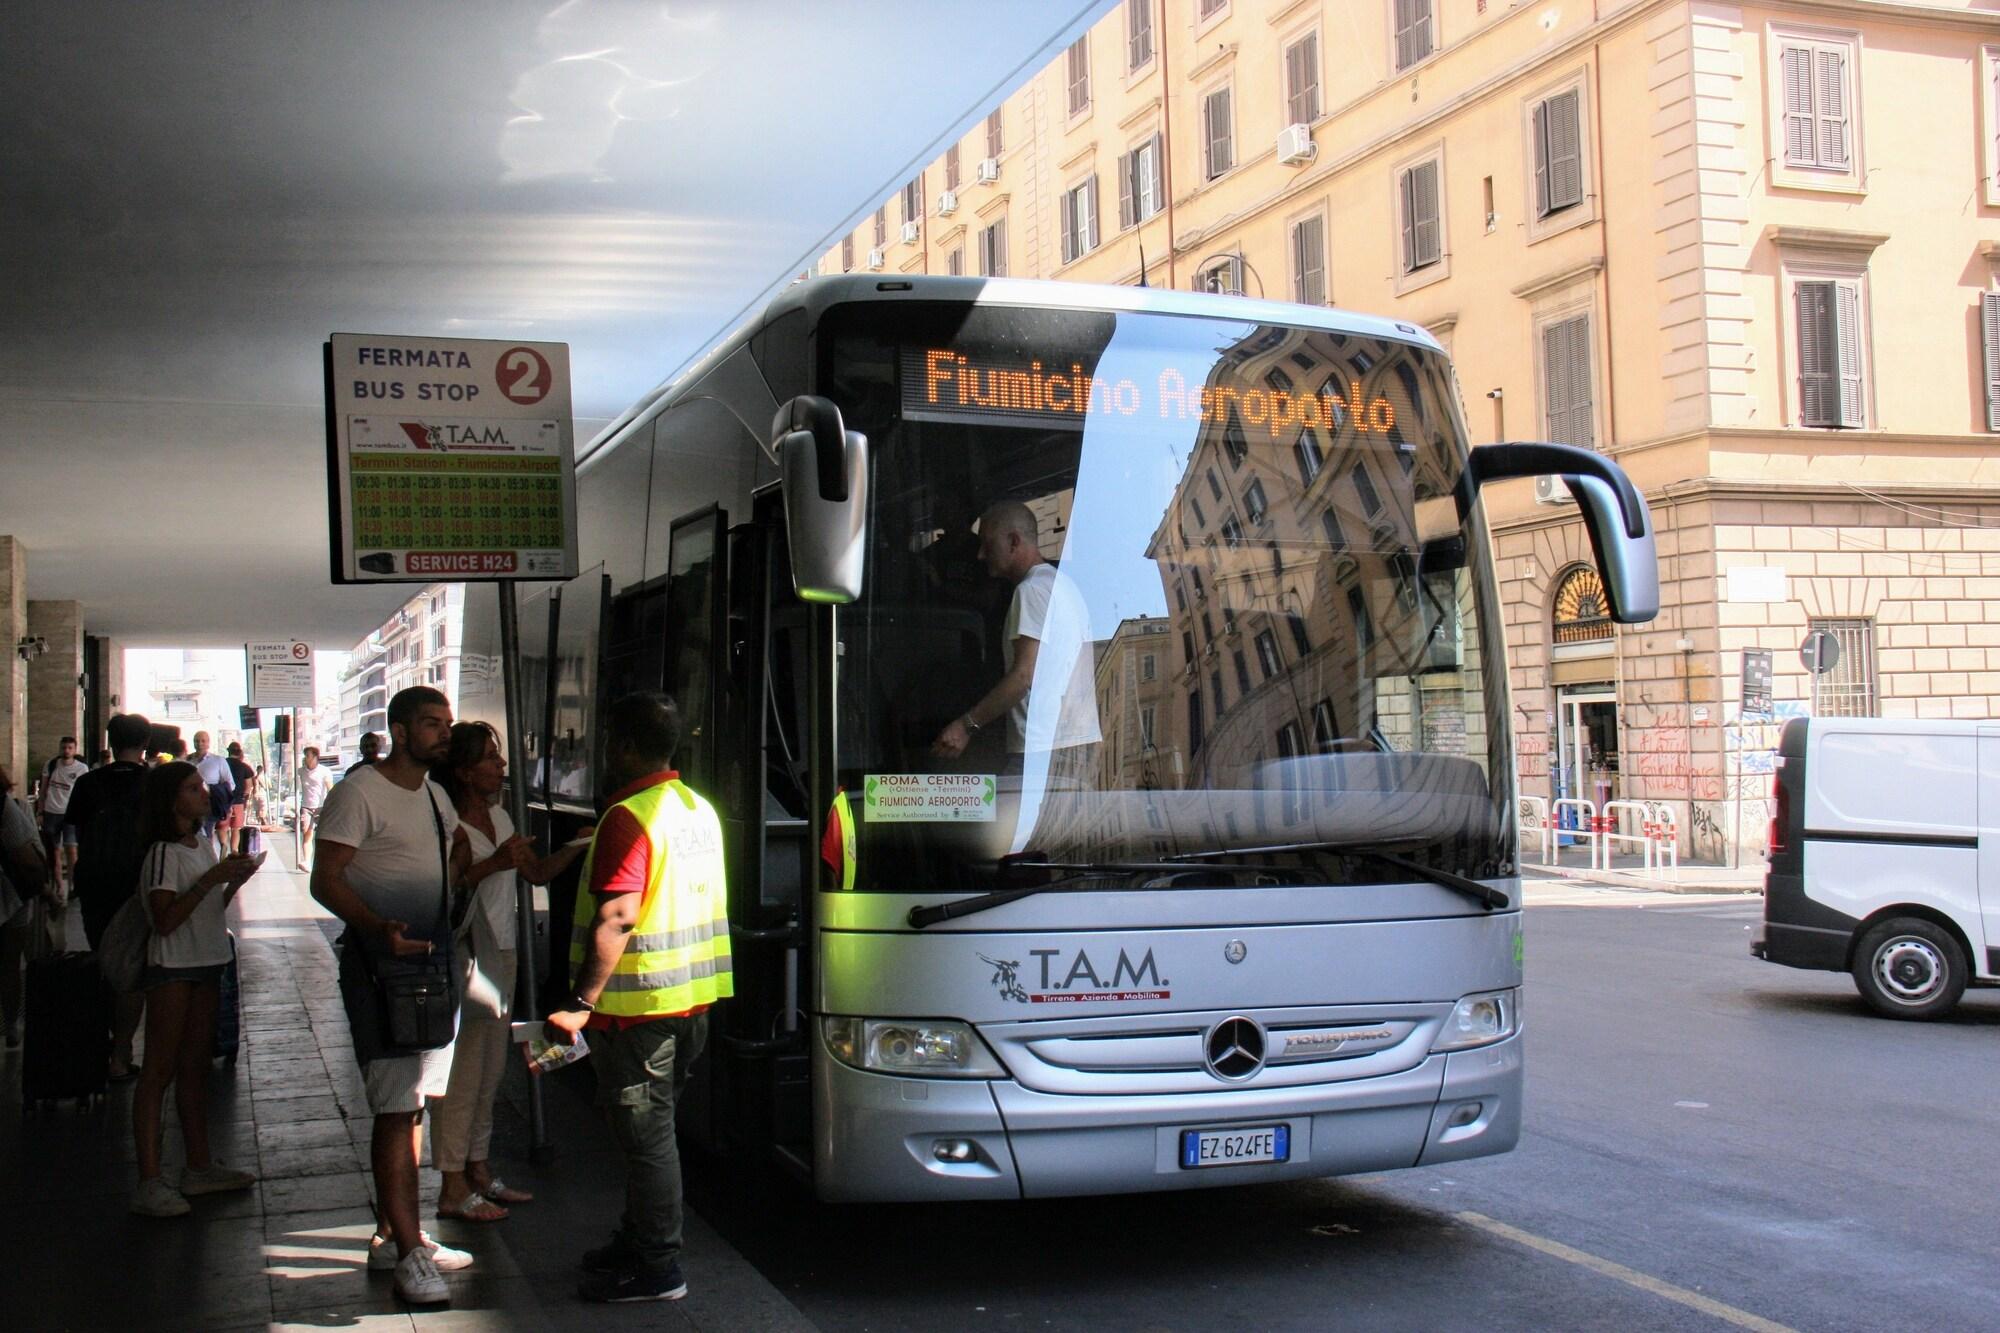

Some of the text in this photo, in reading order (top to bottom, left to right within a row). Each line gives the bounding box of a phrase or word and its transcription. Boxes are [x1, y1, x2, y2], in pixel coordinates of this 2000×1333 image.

[358, 347, 471, 369] FERMATA
[506, 351, 541, 398] 2
[353, 381, 480, 401] BUS STOP
[927, 349, 1395, 437] Fiumicino Aeroporto
[446, 424, 509, 445] T.A.M.
[353, 456, 559, 471] Termini Station Fiumicino Airport
[410, 555, 513, 570] SERVICE H24
[880, 775, 981, 785] ROMA CENTRO
[880, 796, 981, 806] FIUMICINO AEROPORTO
[1029, 946, 1170, 990] T.A.M.
[1081, 993, 1118, 1001] Azienda
[1201, 1134, 1273, 1159] EZ 624FE
